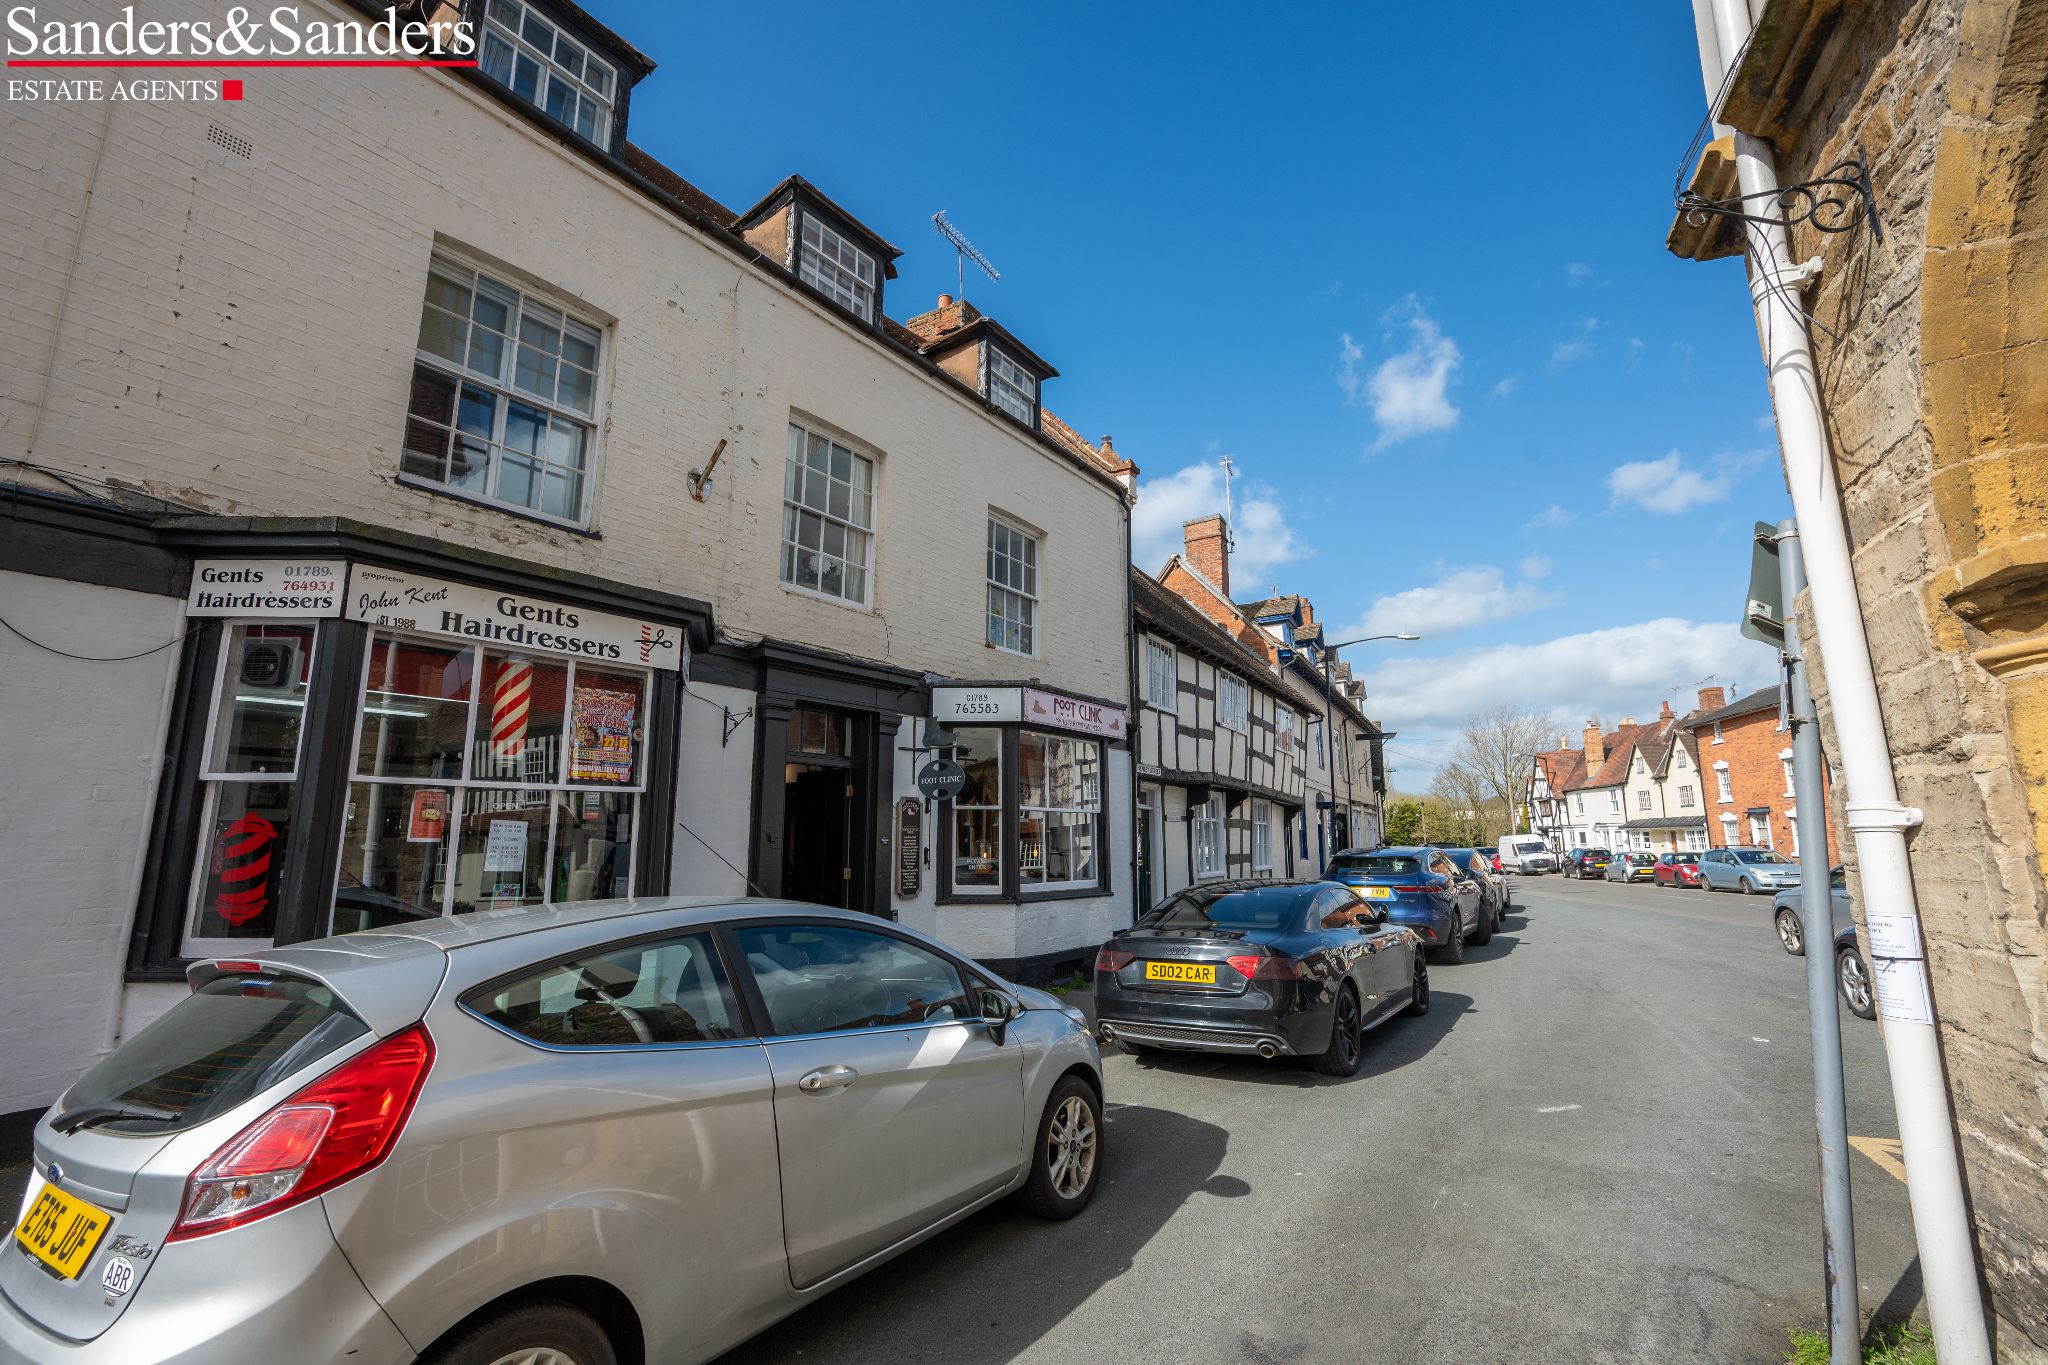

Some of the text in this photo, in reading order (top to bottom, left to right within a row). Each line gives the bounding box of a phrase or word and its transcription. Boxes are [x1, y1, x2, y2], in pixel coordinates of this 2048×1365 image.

[201, 567, 264, 583] Gents
[284, 566, 330, 577] 01789
[361, 571, 406, 584] proprietor
[282, 580, 335, 592] 764931
[196, 592, 333, 609] Hairdressers
[404, 586, 449, 605] Kent
[359, 590, 400, 618] John
[497, 596, 580, 629] Gents
[393, 617, 416, 629] 1988
[440, 610, 621, 659] Hairdressers
[966, 694, 988, 702] 01789
[955, 703, 999, 714] 765583
[1053, 697, 1103, 724] FOOT CLINIC
[921, 775, 962, 785] FOOT CLINIC
[492, 802, 519, 810] OPEN
[1185, 966, 1210, 981] CAR
[49, 1213, 98, 1265] JUF
[104, 1262, 132, 1291] ABR
